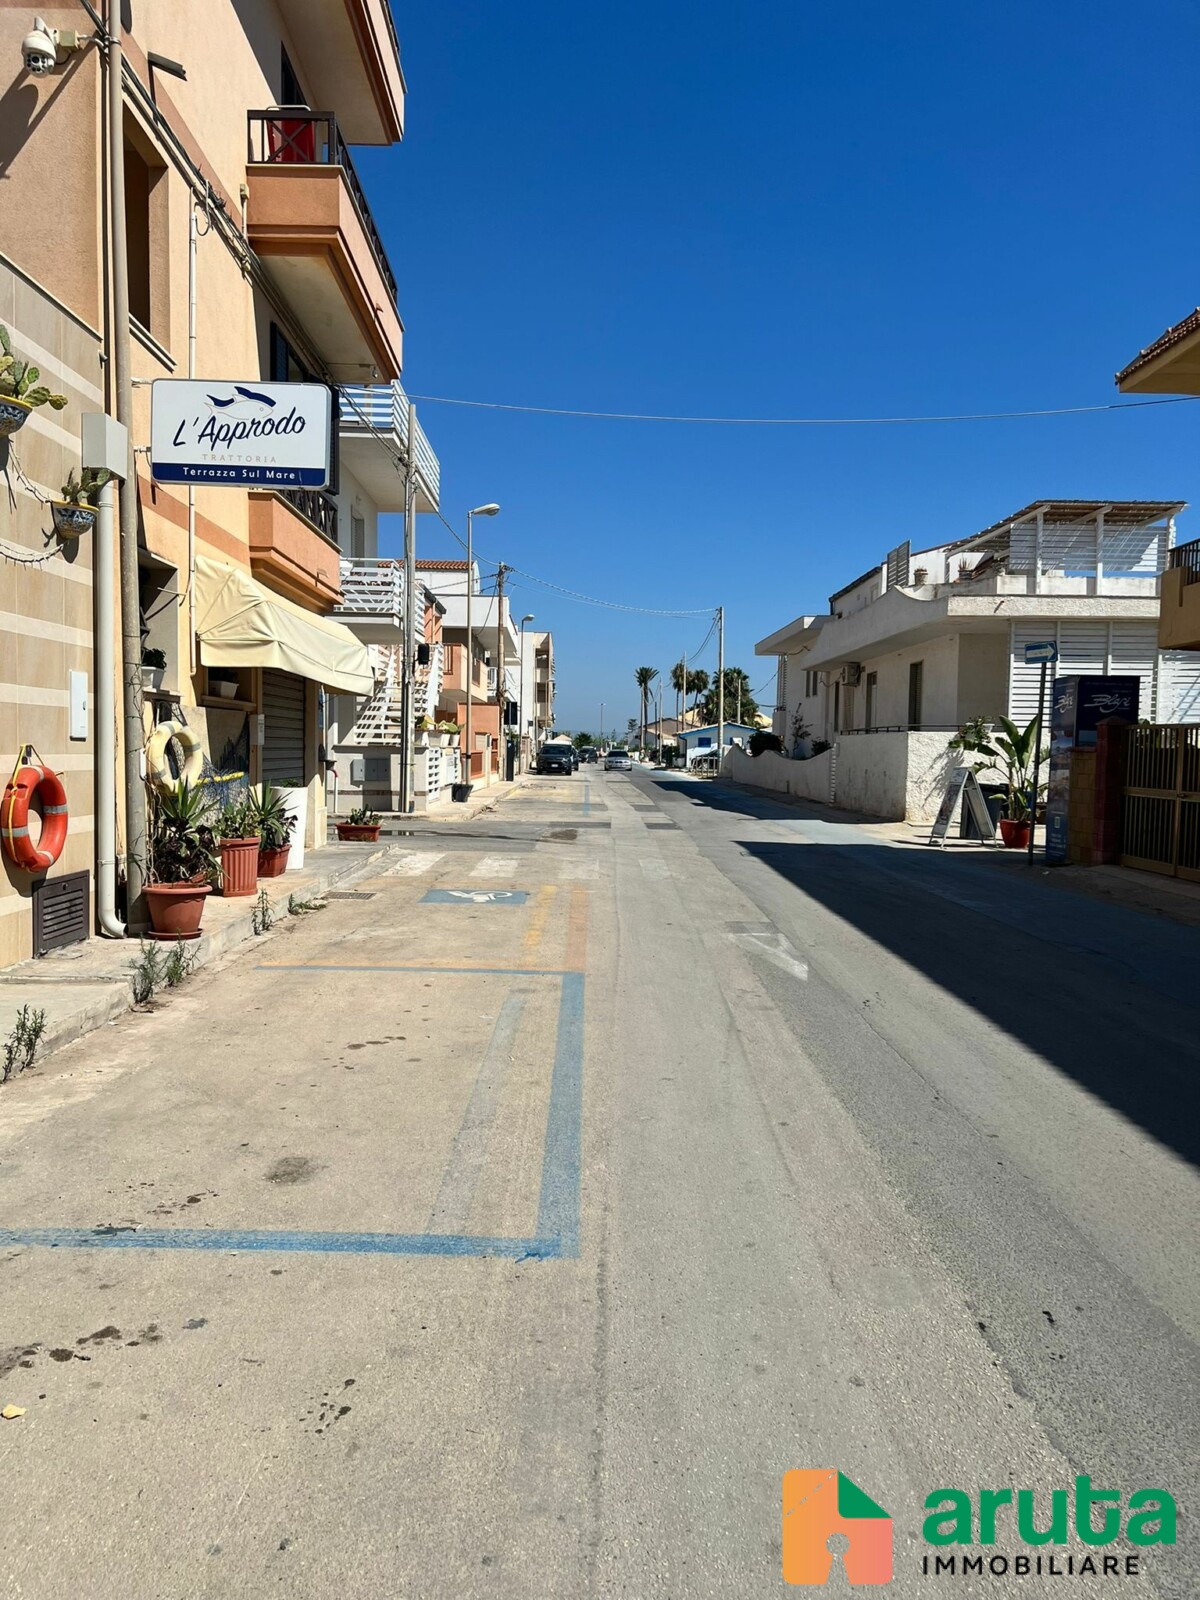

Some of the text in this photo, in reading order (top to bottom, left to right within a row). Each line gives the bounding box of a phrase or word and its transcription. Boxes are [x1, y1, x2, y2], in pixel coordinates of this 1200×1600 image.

[172, 406, 307, 451] L'Approdo
[202, 453, 277, 464] TRATTORIA
[183, 466, 296, 480] Terrazza Sul Mare
